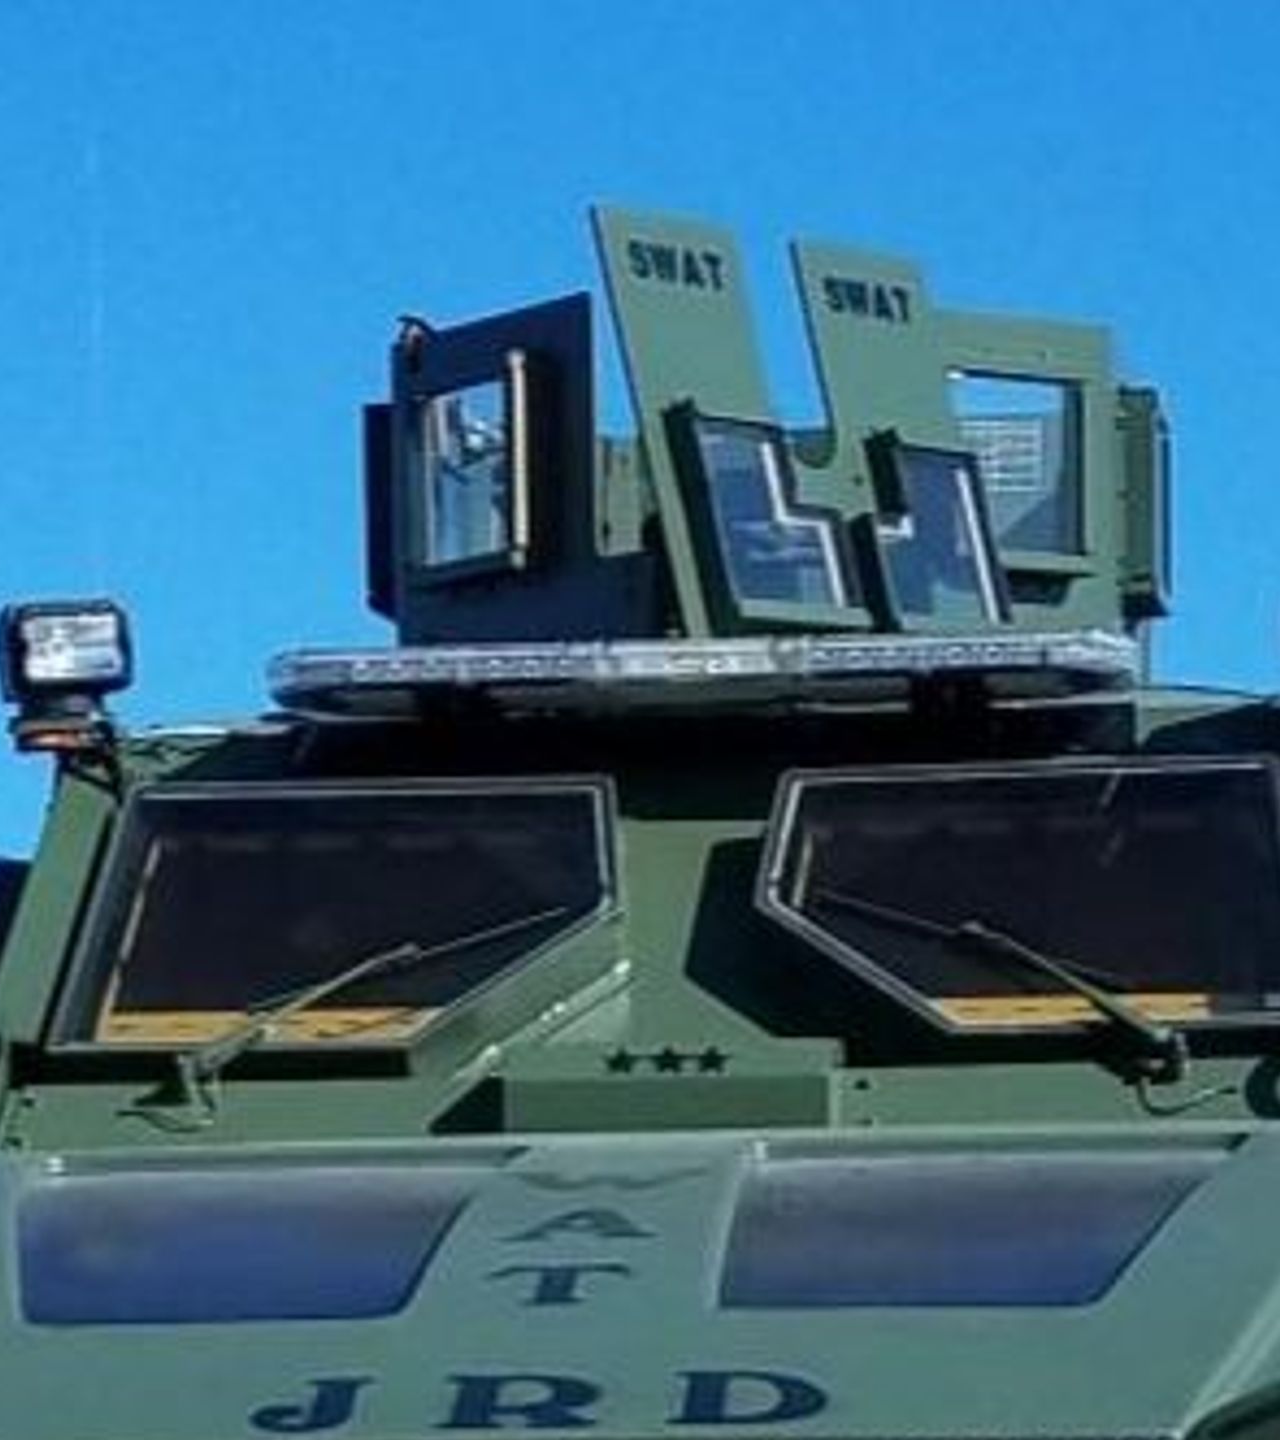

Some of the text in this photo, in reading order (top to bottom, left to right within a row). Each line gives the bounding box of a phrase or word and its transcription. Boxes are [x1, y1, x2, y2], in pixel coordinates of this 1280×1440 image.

[628, 239, 724, 292] SWAT
[823, 275, 911, 323] SWAT
[250, 1370, 828, 1433] JRD
